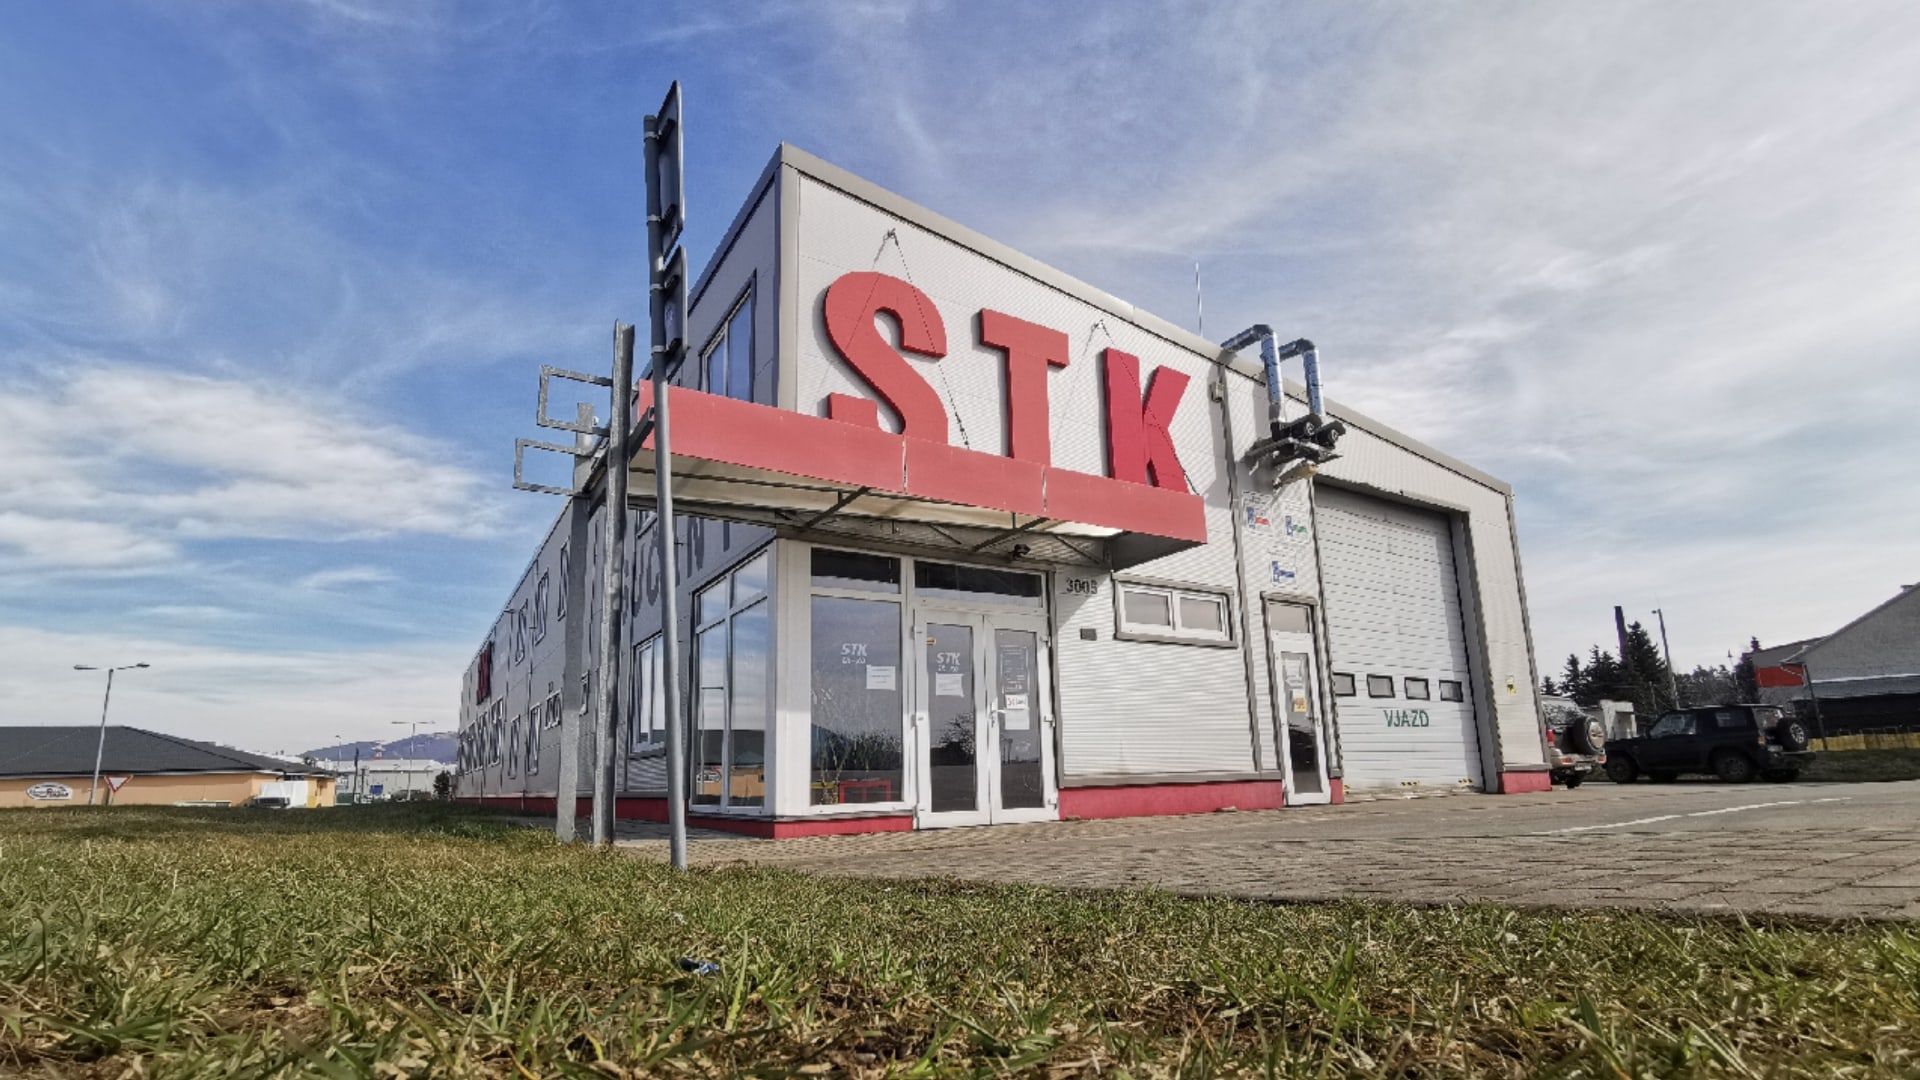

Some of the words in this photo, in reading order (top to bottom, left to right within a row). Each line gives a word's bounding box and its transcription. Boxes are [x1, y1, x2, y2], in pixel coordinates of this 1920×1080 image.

[824, 272, 1189, 492] STK
[840, 642, 868, 656] STK
[936, 651, 961, 665] STK
[1384, 709, 1430, 728] VJAZD
